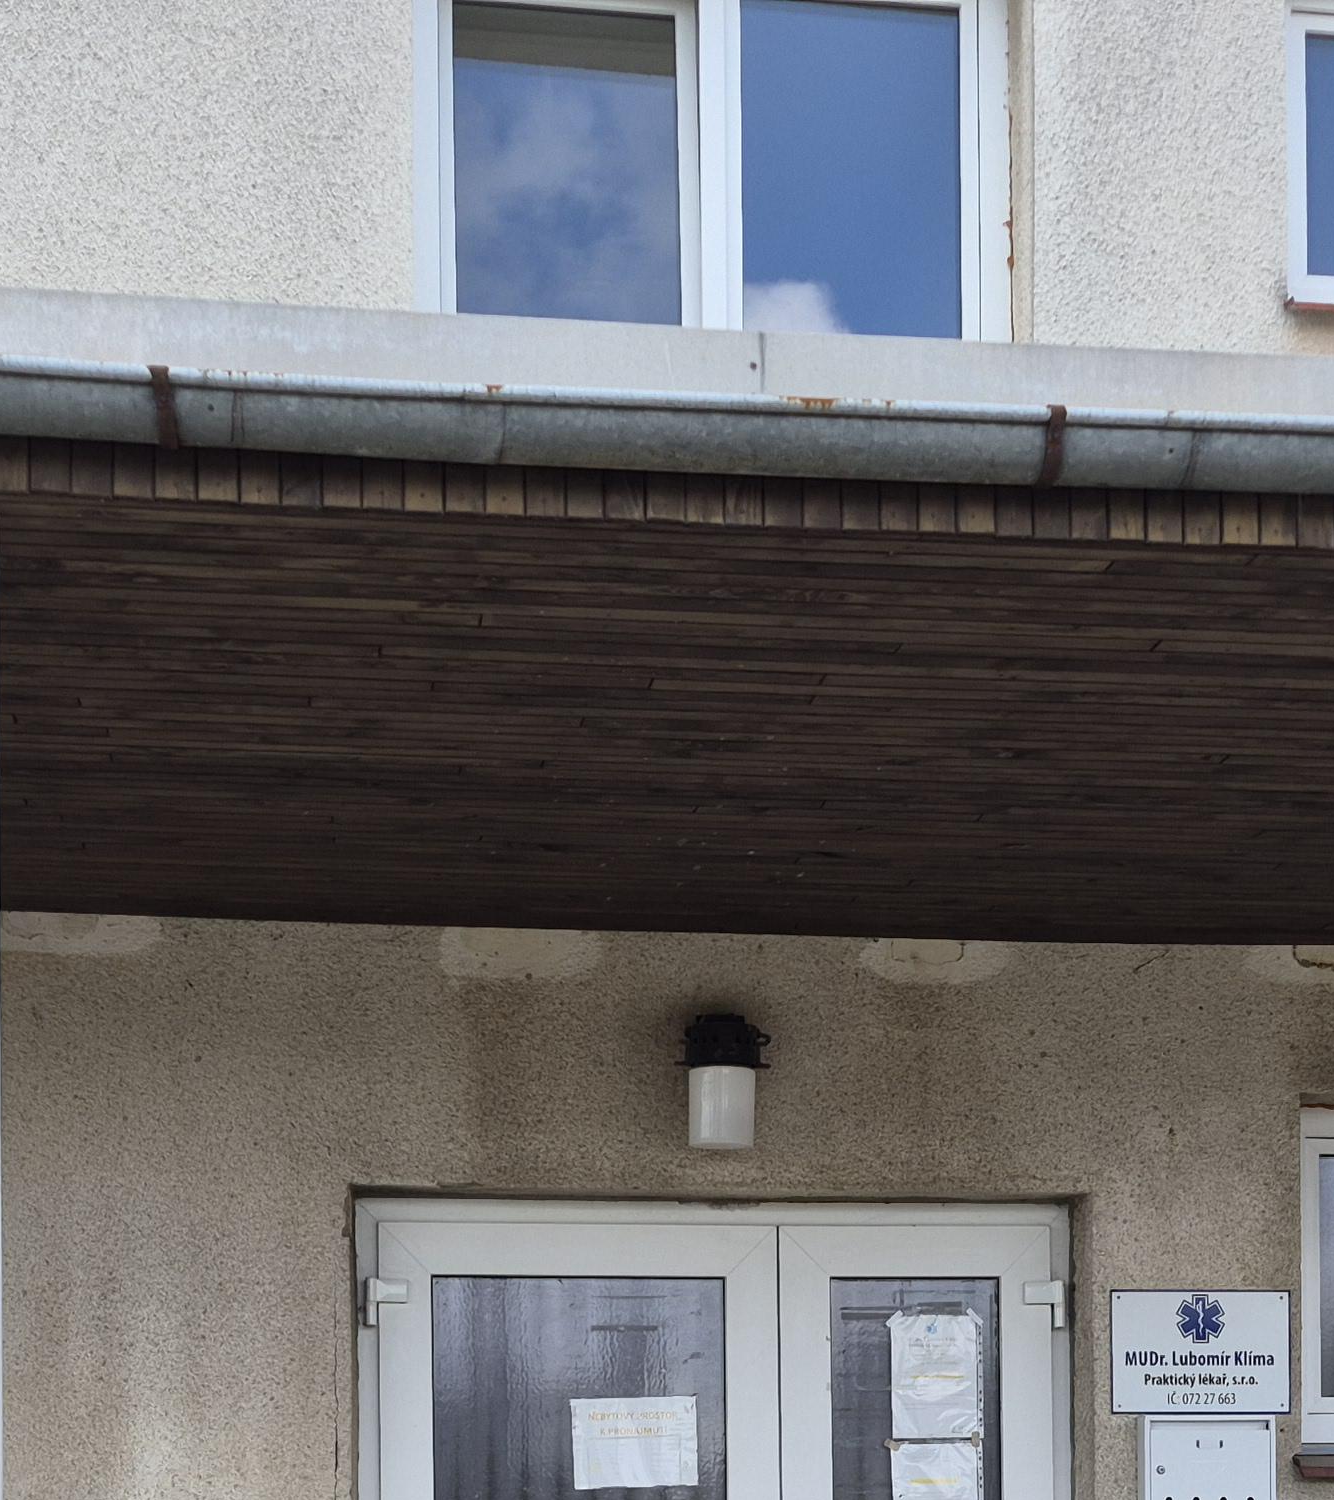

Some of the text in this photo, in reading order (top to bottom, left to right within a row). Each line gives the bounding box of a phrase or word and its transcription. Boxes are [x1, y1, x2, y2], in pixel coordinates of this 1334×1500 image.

[1124, 1350, 1275, 1367] MUDr. Lubomír Klíma
[1144, 1373, 1259, 1388] Praktický lékař, s.r.o.
[1182, 1392, 1201, 1405] 072
[1204, 1392, 1216, 1405] 27
[1218, 1392, 1236, 1405] 663
